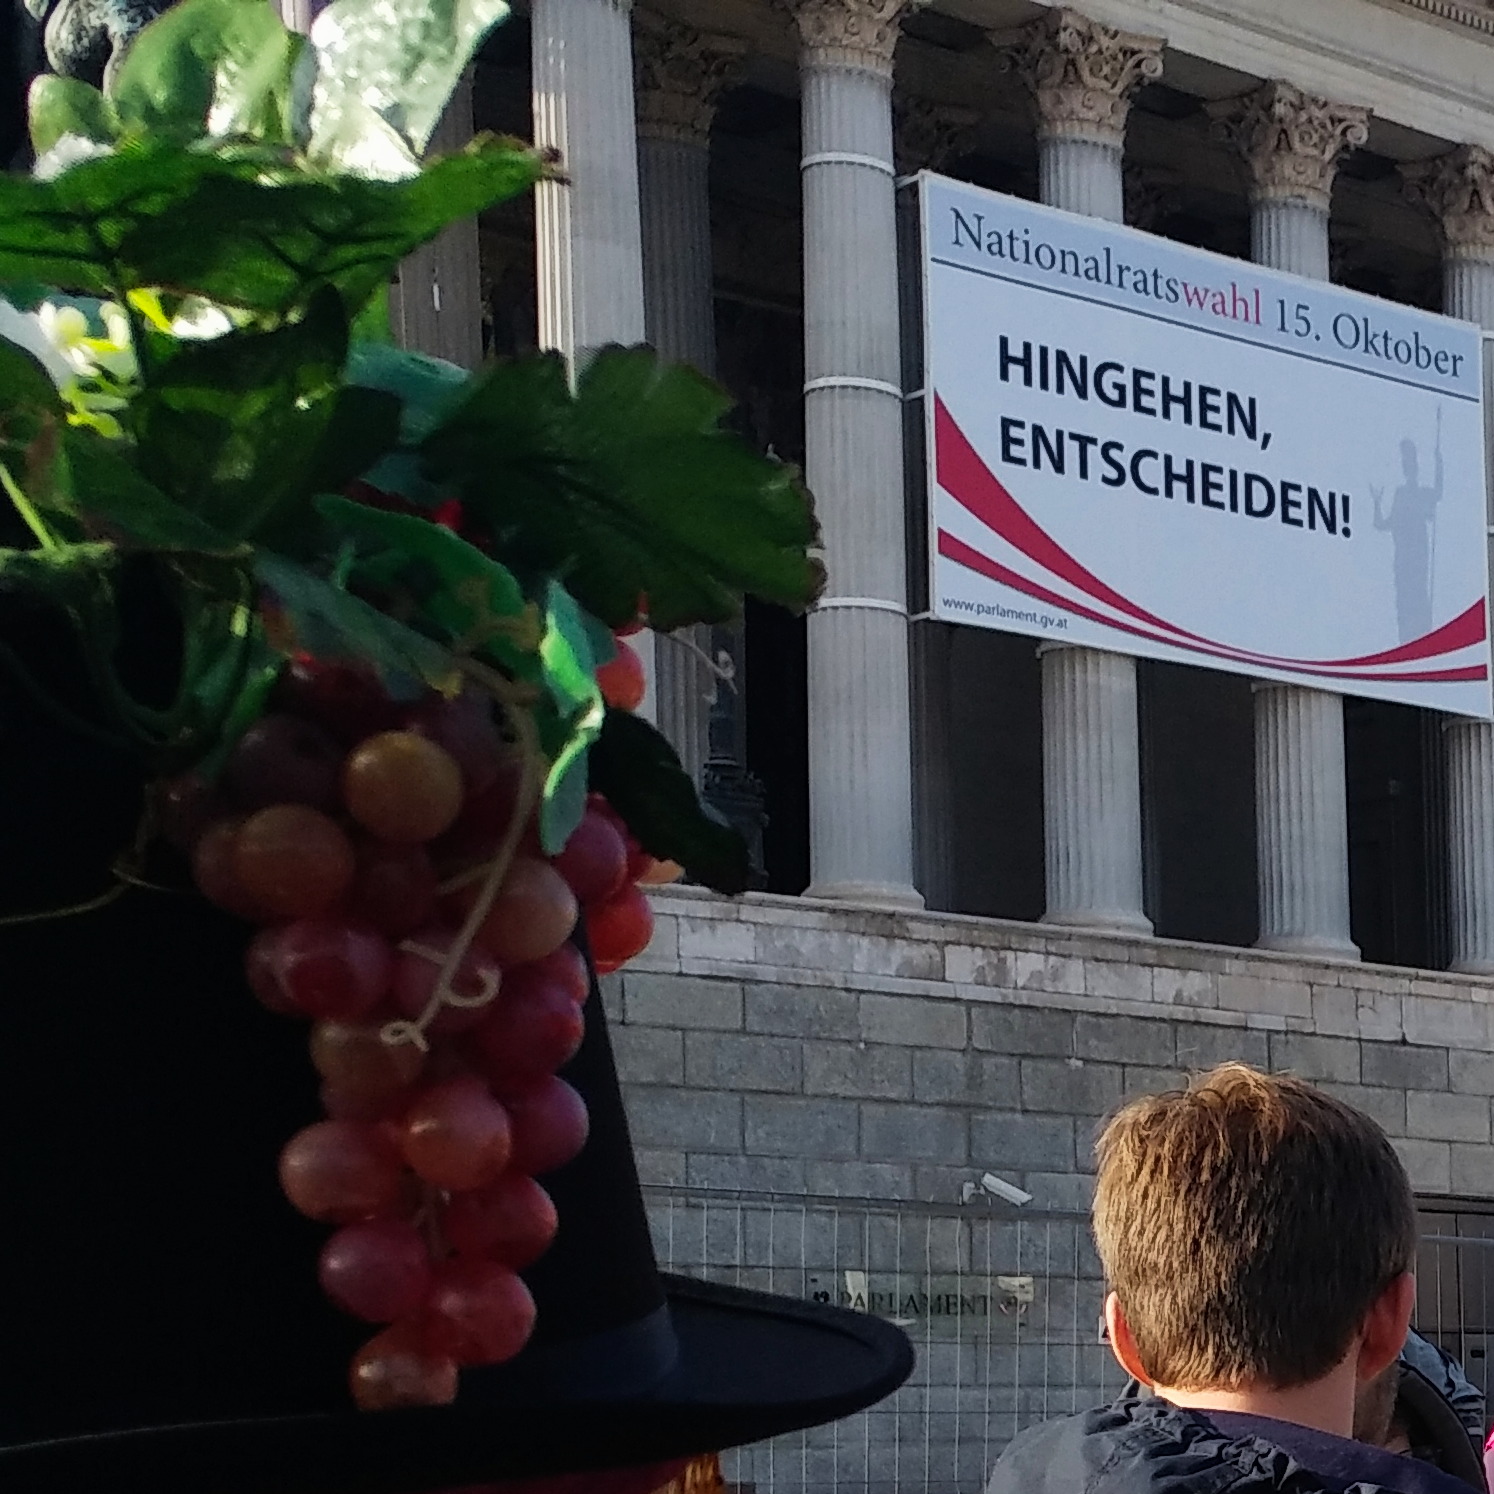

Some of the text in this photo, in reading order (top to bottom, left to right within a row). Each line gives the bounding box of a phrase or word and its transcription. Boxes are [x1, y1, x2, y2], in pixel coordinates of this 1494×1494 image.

[951, 206, 1465, 378] Nationalratswahl 15. Oktober
[999, 334, 1273, 451] HINGEHEN,
[1000, 415, 1353, 539] ENTSCHEIDEN!
[942, 597, 1068, 630] www.parlament.gv.at
[841, 1292, 990, 1316] PARLAMENT
